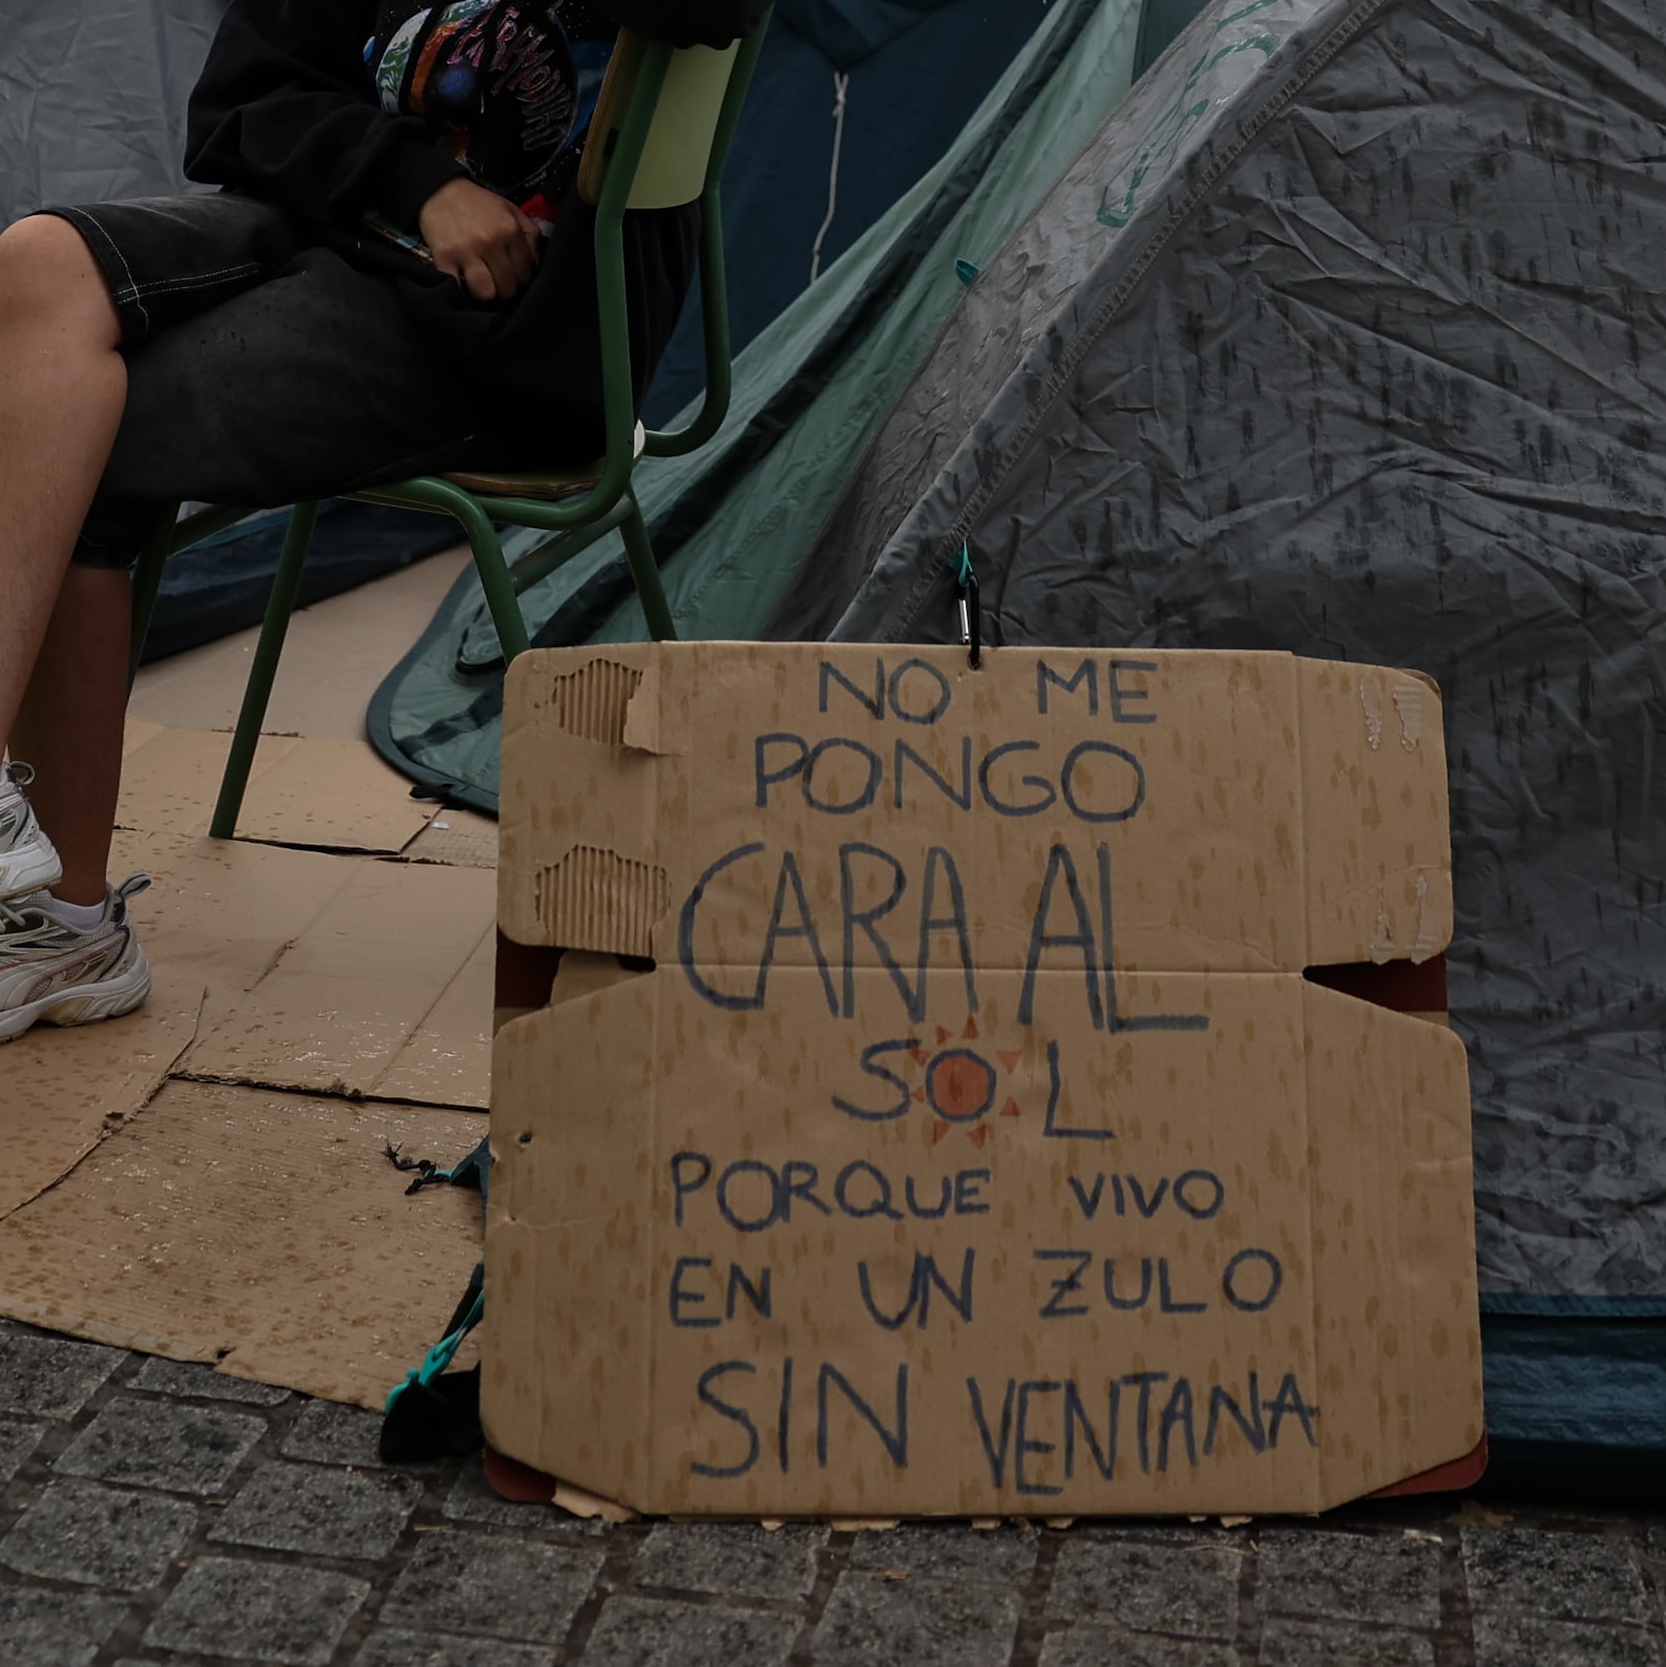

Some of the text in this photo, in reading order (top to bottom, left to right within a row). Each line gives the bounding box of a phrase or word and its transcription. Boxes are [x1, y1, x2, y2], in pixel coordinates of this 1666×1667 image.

[818, 658, 1158, 725] NO ME
[755, 732, 1146, 823] PONGO
[677, 842, 1209, 1034] CARA AL
[833, 1038, 1115, 1141] SOL
[670, 1151, 1225, 1232] PORQUE VIVO
[669, 1247, 1282, 1330] EN UN ZULO
[693, 1357, 1317, 1495] SIN VENTANA
